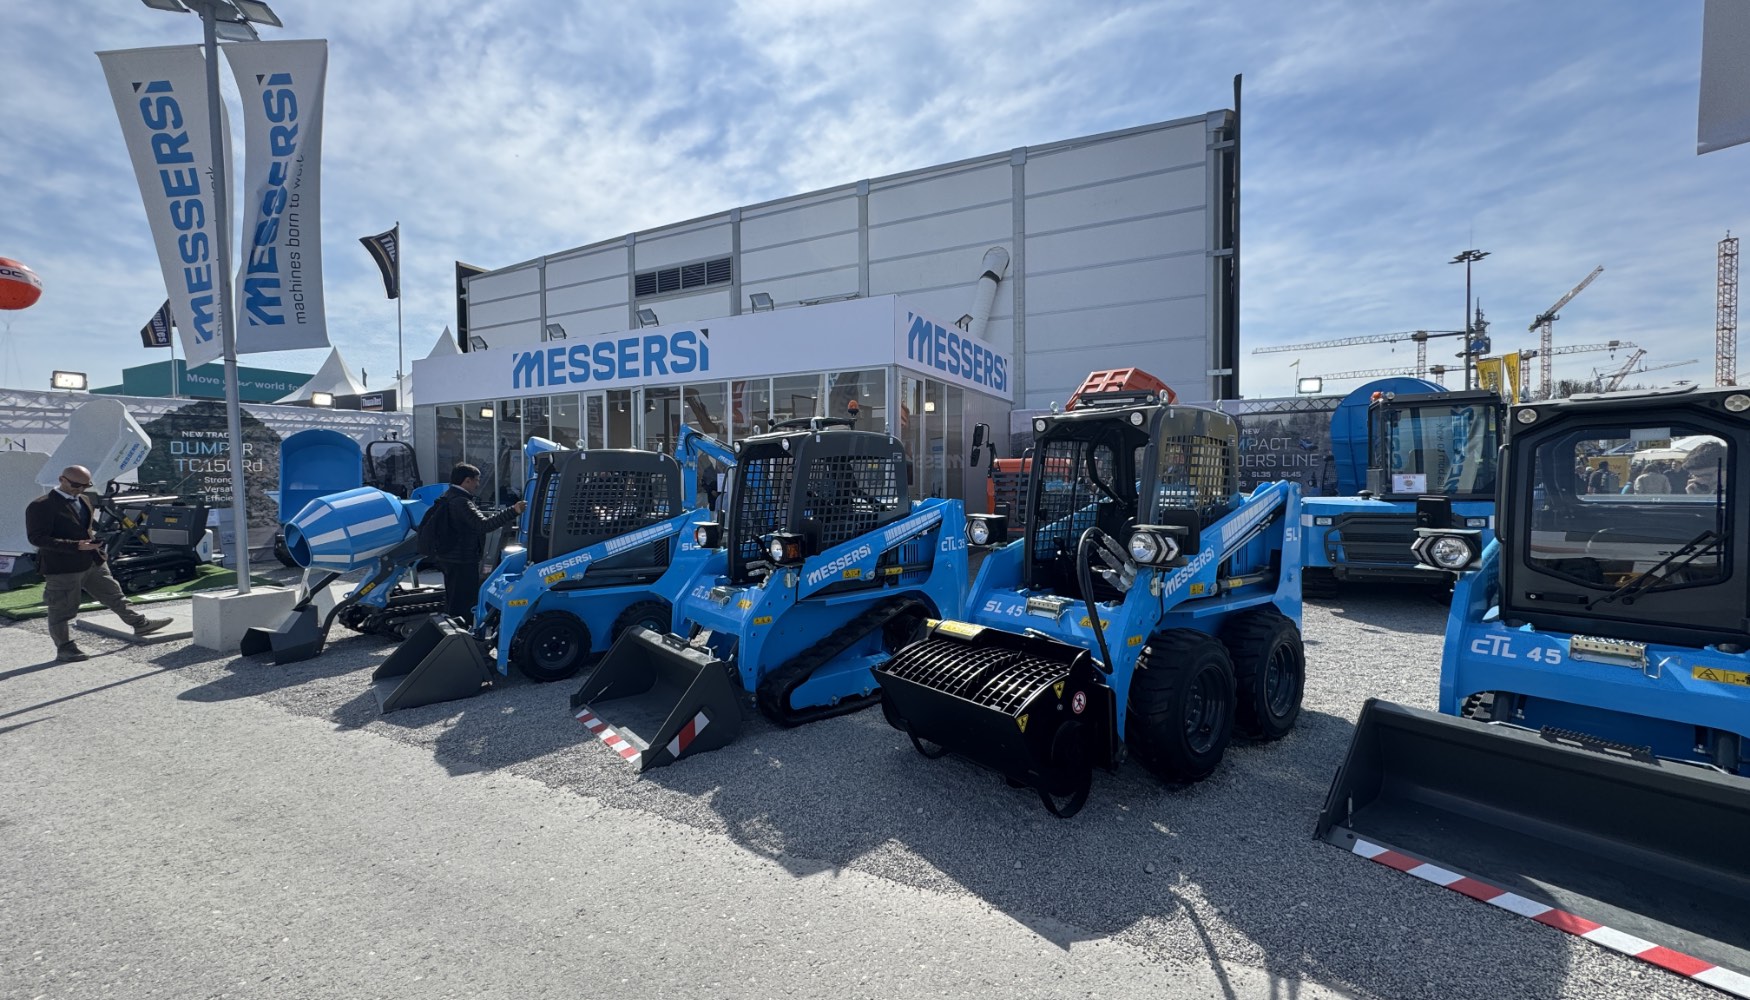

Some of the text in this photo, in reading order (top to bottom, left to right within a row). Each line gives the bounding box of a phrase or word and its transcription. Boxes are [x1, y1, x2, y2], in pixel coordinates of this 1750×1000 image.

[289, 193, 301, 208] to
[285, 213, 301, 247] born
[289, 269, 307, 324] machines
[187, 374, 219, 385] Move
[255, 382, 285, 391] world
[170, 441, 254, 456] DUMPR
[1282, 454, 1320, 467] LINE
[983, 600, 1025, 617] SL 45
[1526, 646, 1562, 665] 45
